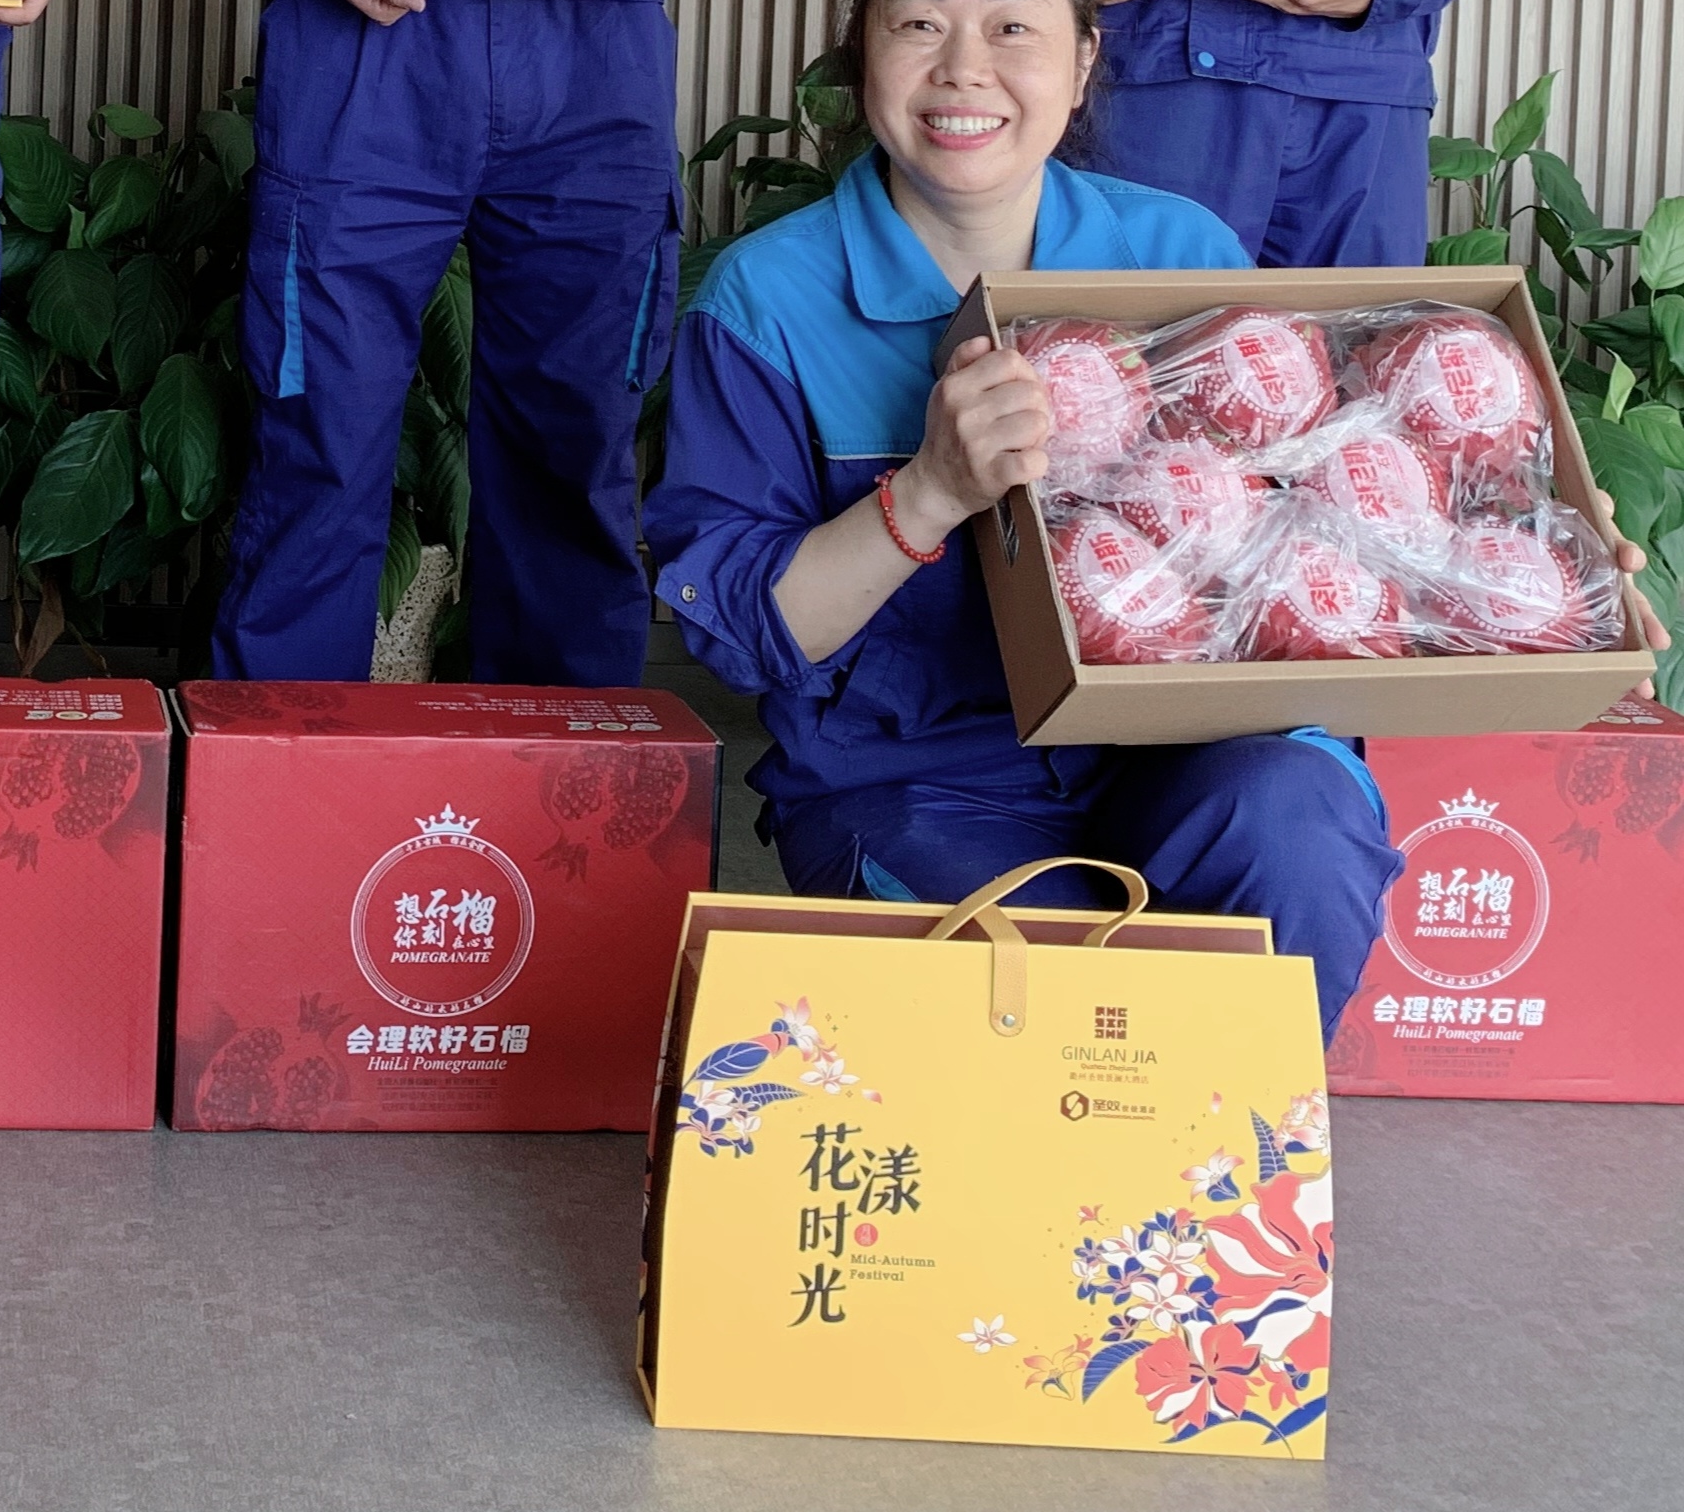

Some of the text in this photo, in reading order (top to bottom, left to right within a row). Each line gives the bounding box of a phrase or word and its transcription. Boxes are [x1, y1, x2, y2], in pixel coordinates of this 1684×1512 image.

[1472, 913, 1512, 927] 在心里
[1414, 926, 1509, 939] POMEGRANATE
[452, 935, 495, 950] 在心里
[390, 951, 491, 963] POMEGRANATE
[1373, 994, 1546, 1026] 会理软籽石榴
[346, 1024, 531, 1054] 会理软籽石榴
[1393, 1025, 1524, 1043] HuiLi Pomegranate
[1061, 1046, 1158, 1064] GINLAN JIA
[367, 1056, 507, 1074] HuiLi Pomegranate
[850, 1254, 936, 1268] Mid-Autumn
[849, 1269, 905, 1282] Festival
